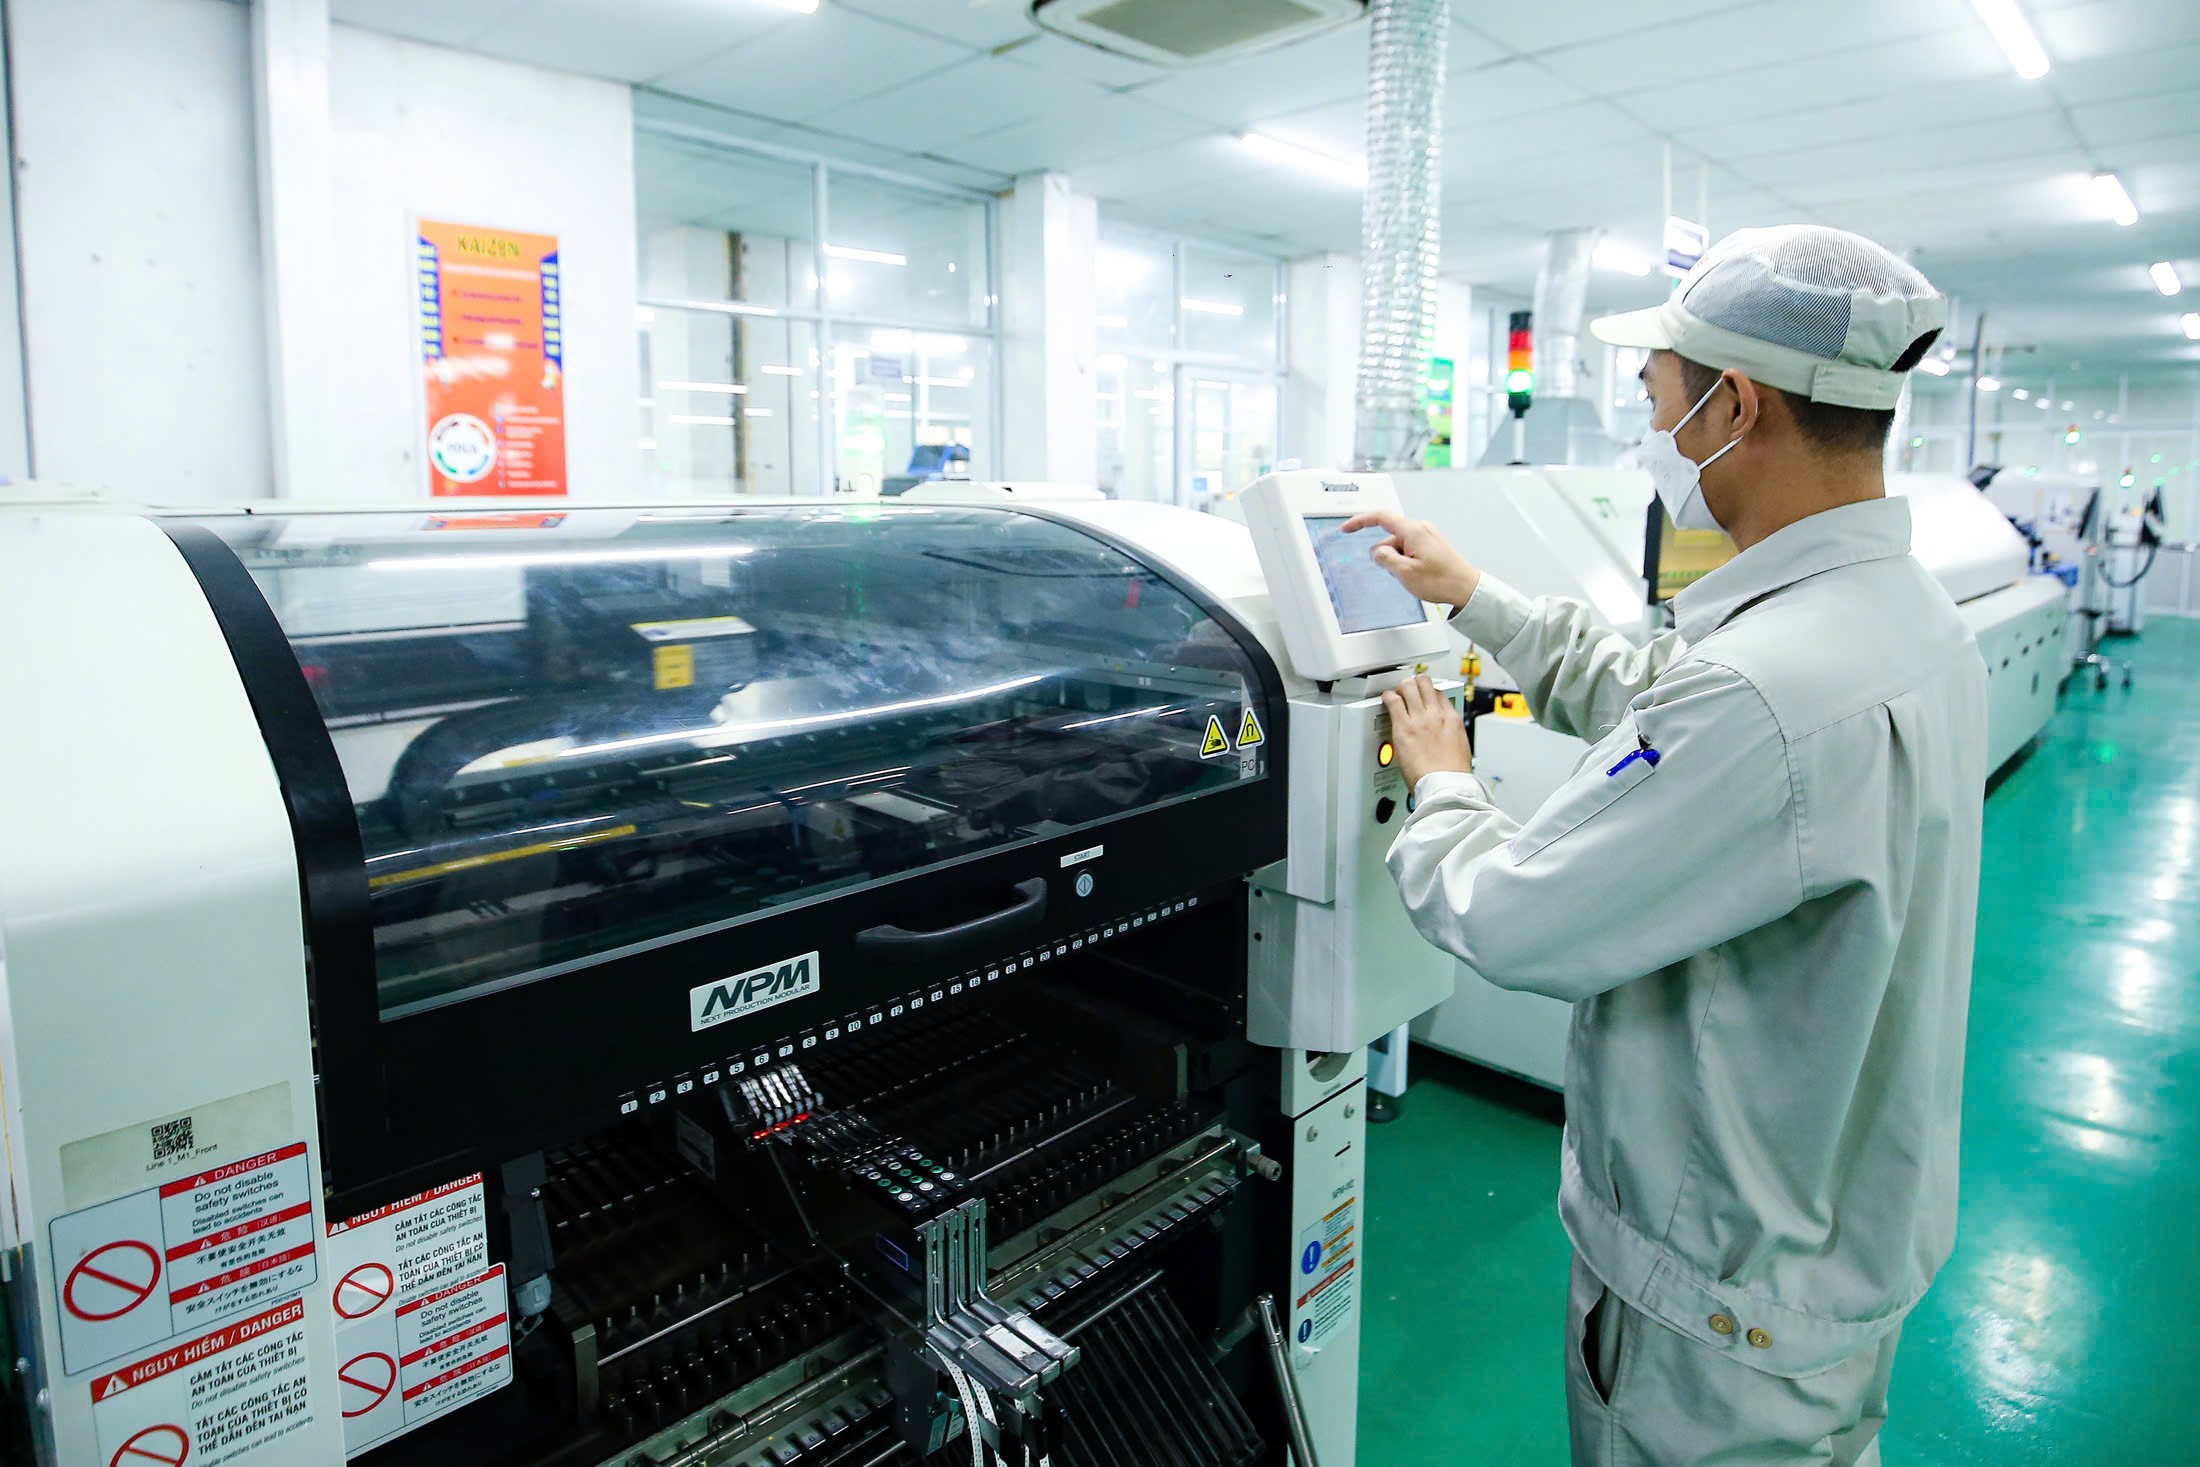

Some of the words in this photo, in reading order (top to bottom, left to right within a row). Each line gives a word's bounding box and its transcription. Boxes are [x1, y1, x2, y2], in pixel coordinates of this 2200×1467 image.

[1073, 851, 1091, 862] START
[701, 958, 809, 1018] NPM
[701, 1014, 722, 1025] NEXT
[723, 997, 773, 1017] PRODUCTION
[774, 984, 810, 1000] MODULAR
[214, 1153, 277, 1180] DANGER
[194, 1193, 210, 1204] Do
[214, 1184, 232, 1196] not
[235, 1170, 274, 1189] disable
[195, 1196, 229, 1213] safety
[232, 1179, 279, 1200] switches
[192, 1210, 229, 1227] Disabled
[231, 1197, 267, 1213] switches
[268, 1192, 284, 1201] can
[192, 1224, 211, 1235] lead
[213, 1219, 222, 1228] to
[224, 1206, 263, 1224] accidents
[396, 1232, 407, 1242] AN
[473, 1232, 483, 1242] AN
[435, 1277, 482, 1300] DANGER
[421, 1310, 433, 1319] Do
[434, 1302, 448, 1313] not
[450, 1290, 479, 1306] disable
[421, 1312, 447, 1327] safety
[448, 1297, 483, 1315] switches
[132, 1354, 179, 1383] NGUY
[240, 1305, 303, 1339] DANGER
[191, 1385, 205, 1397] AN
[293, 1376, 306, 1389] AN
[268, 1411, 283, 1424] TAI
